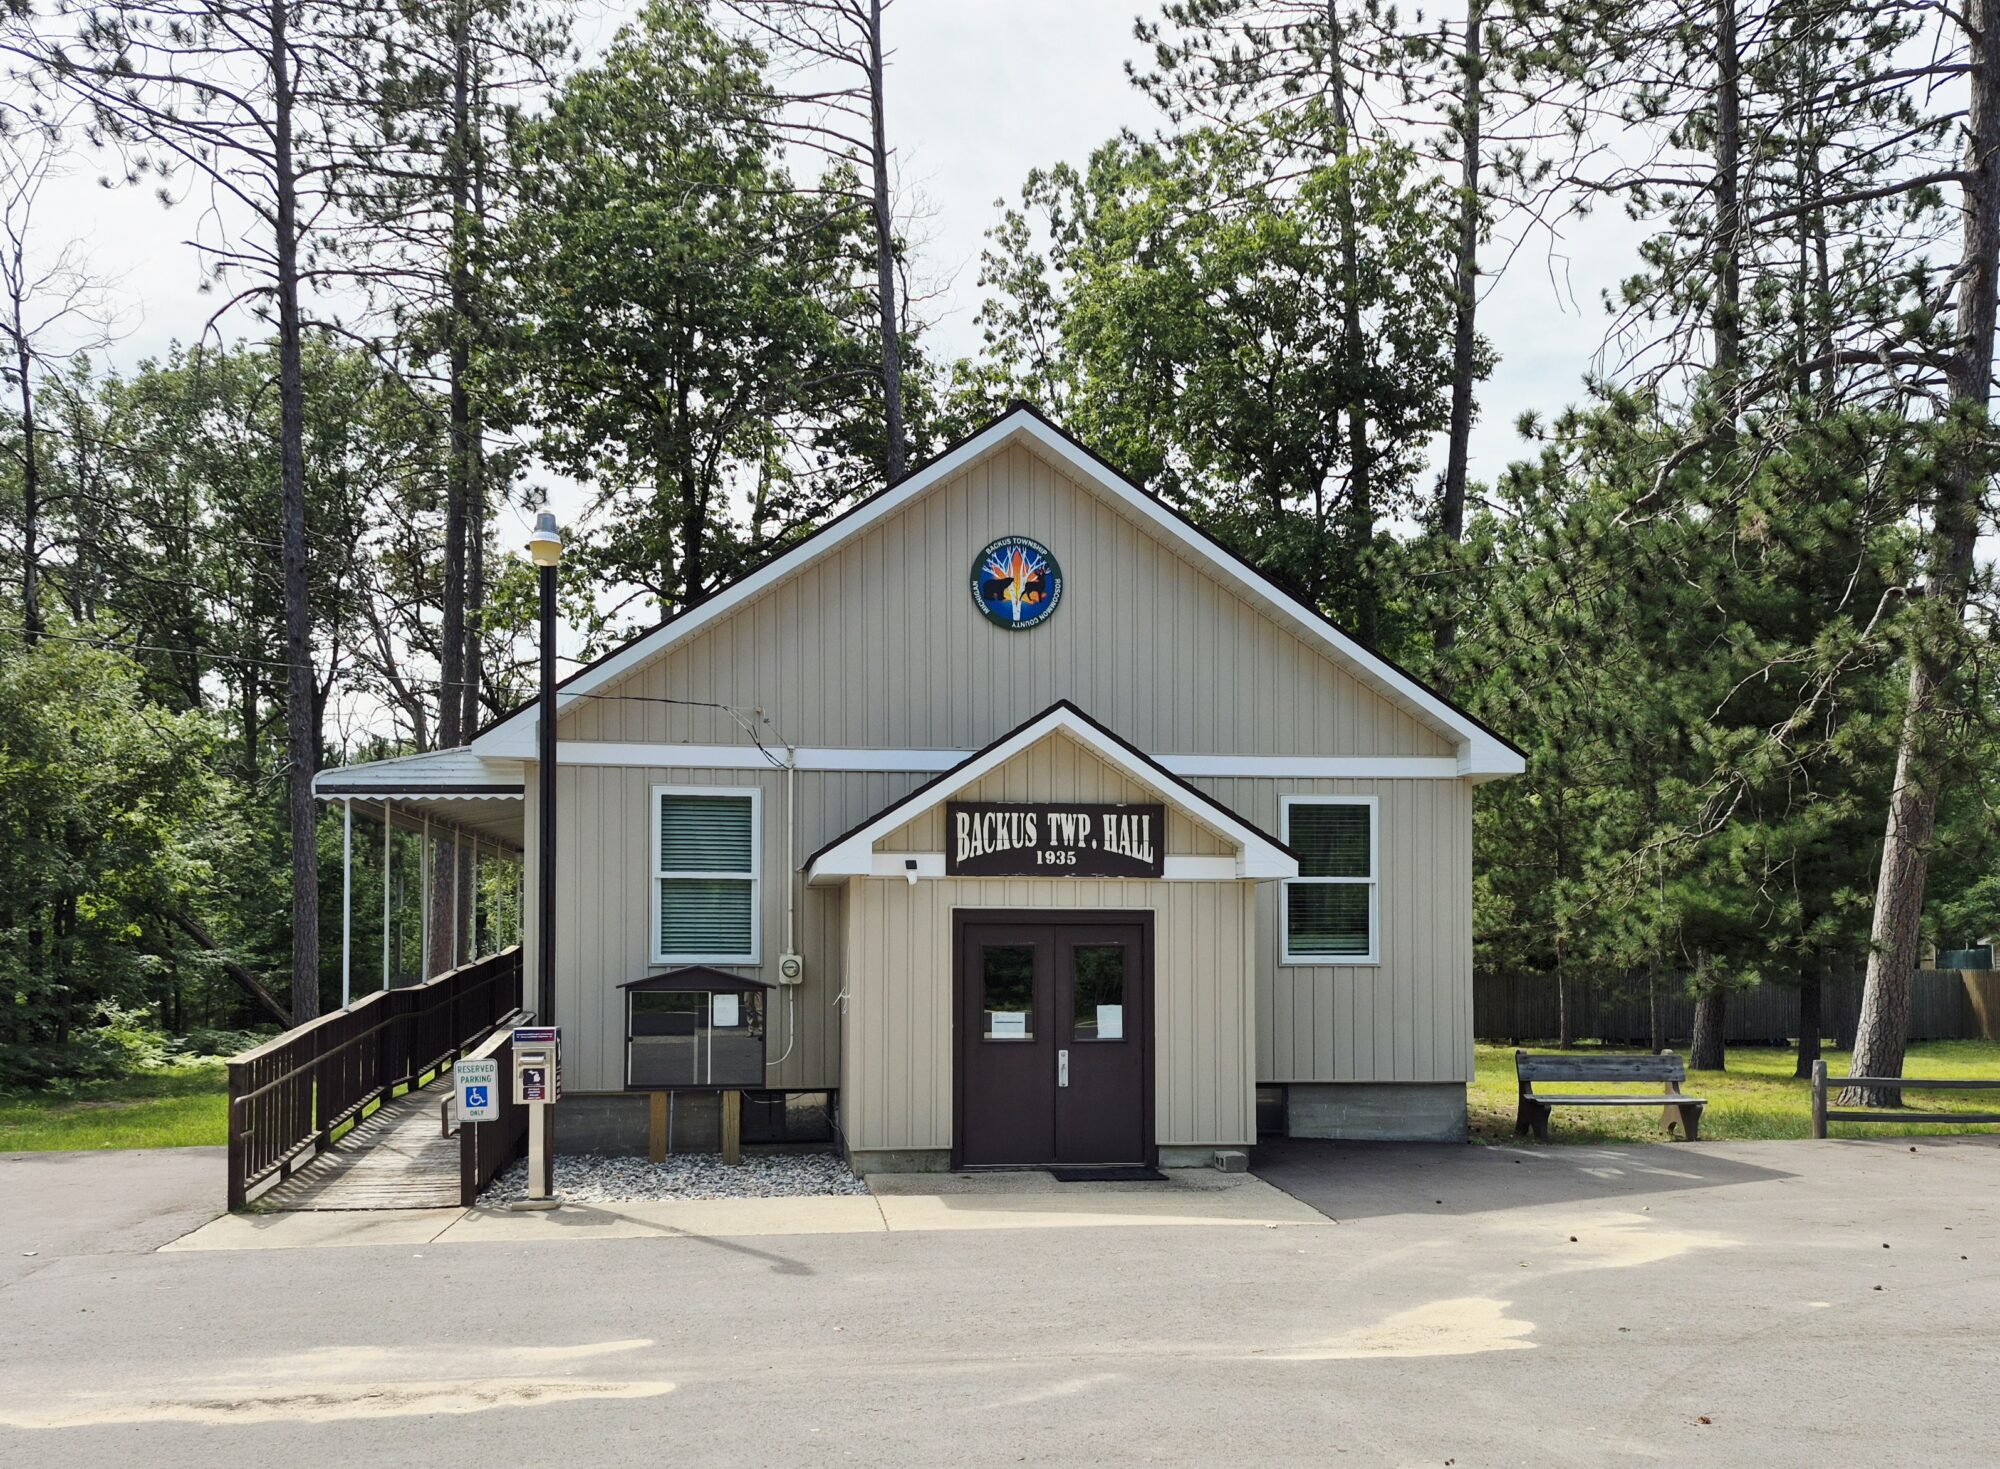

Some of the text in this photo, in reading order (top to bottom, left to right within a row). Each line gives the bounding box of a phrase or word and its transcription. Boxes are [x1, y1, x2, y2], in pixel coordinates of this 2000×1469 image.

[985, 537, 1048, 555] BACKUS TOWNSHIP
[972, 580, 991, 614] MICHIGAN
[1011, 578, 1062, 628] ROSCOMMON COUNTY
[956, 811, 1154, 864] BACKUS TWP. HALL
[1036, 850, 1077, 865] 1935
[457, 1064, 495, 1074] RESERVED
[460, 1075, 492, 1084] PARKING
